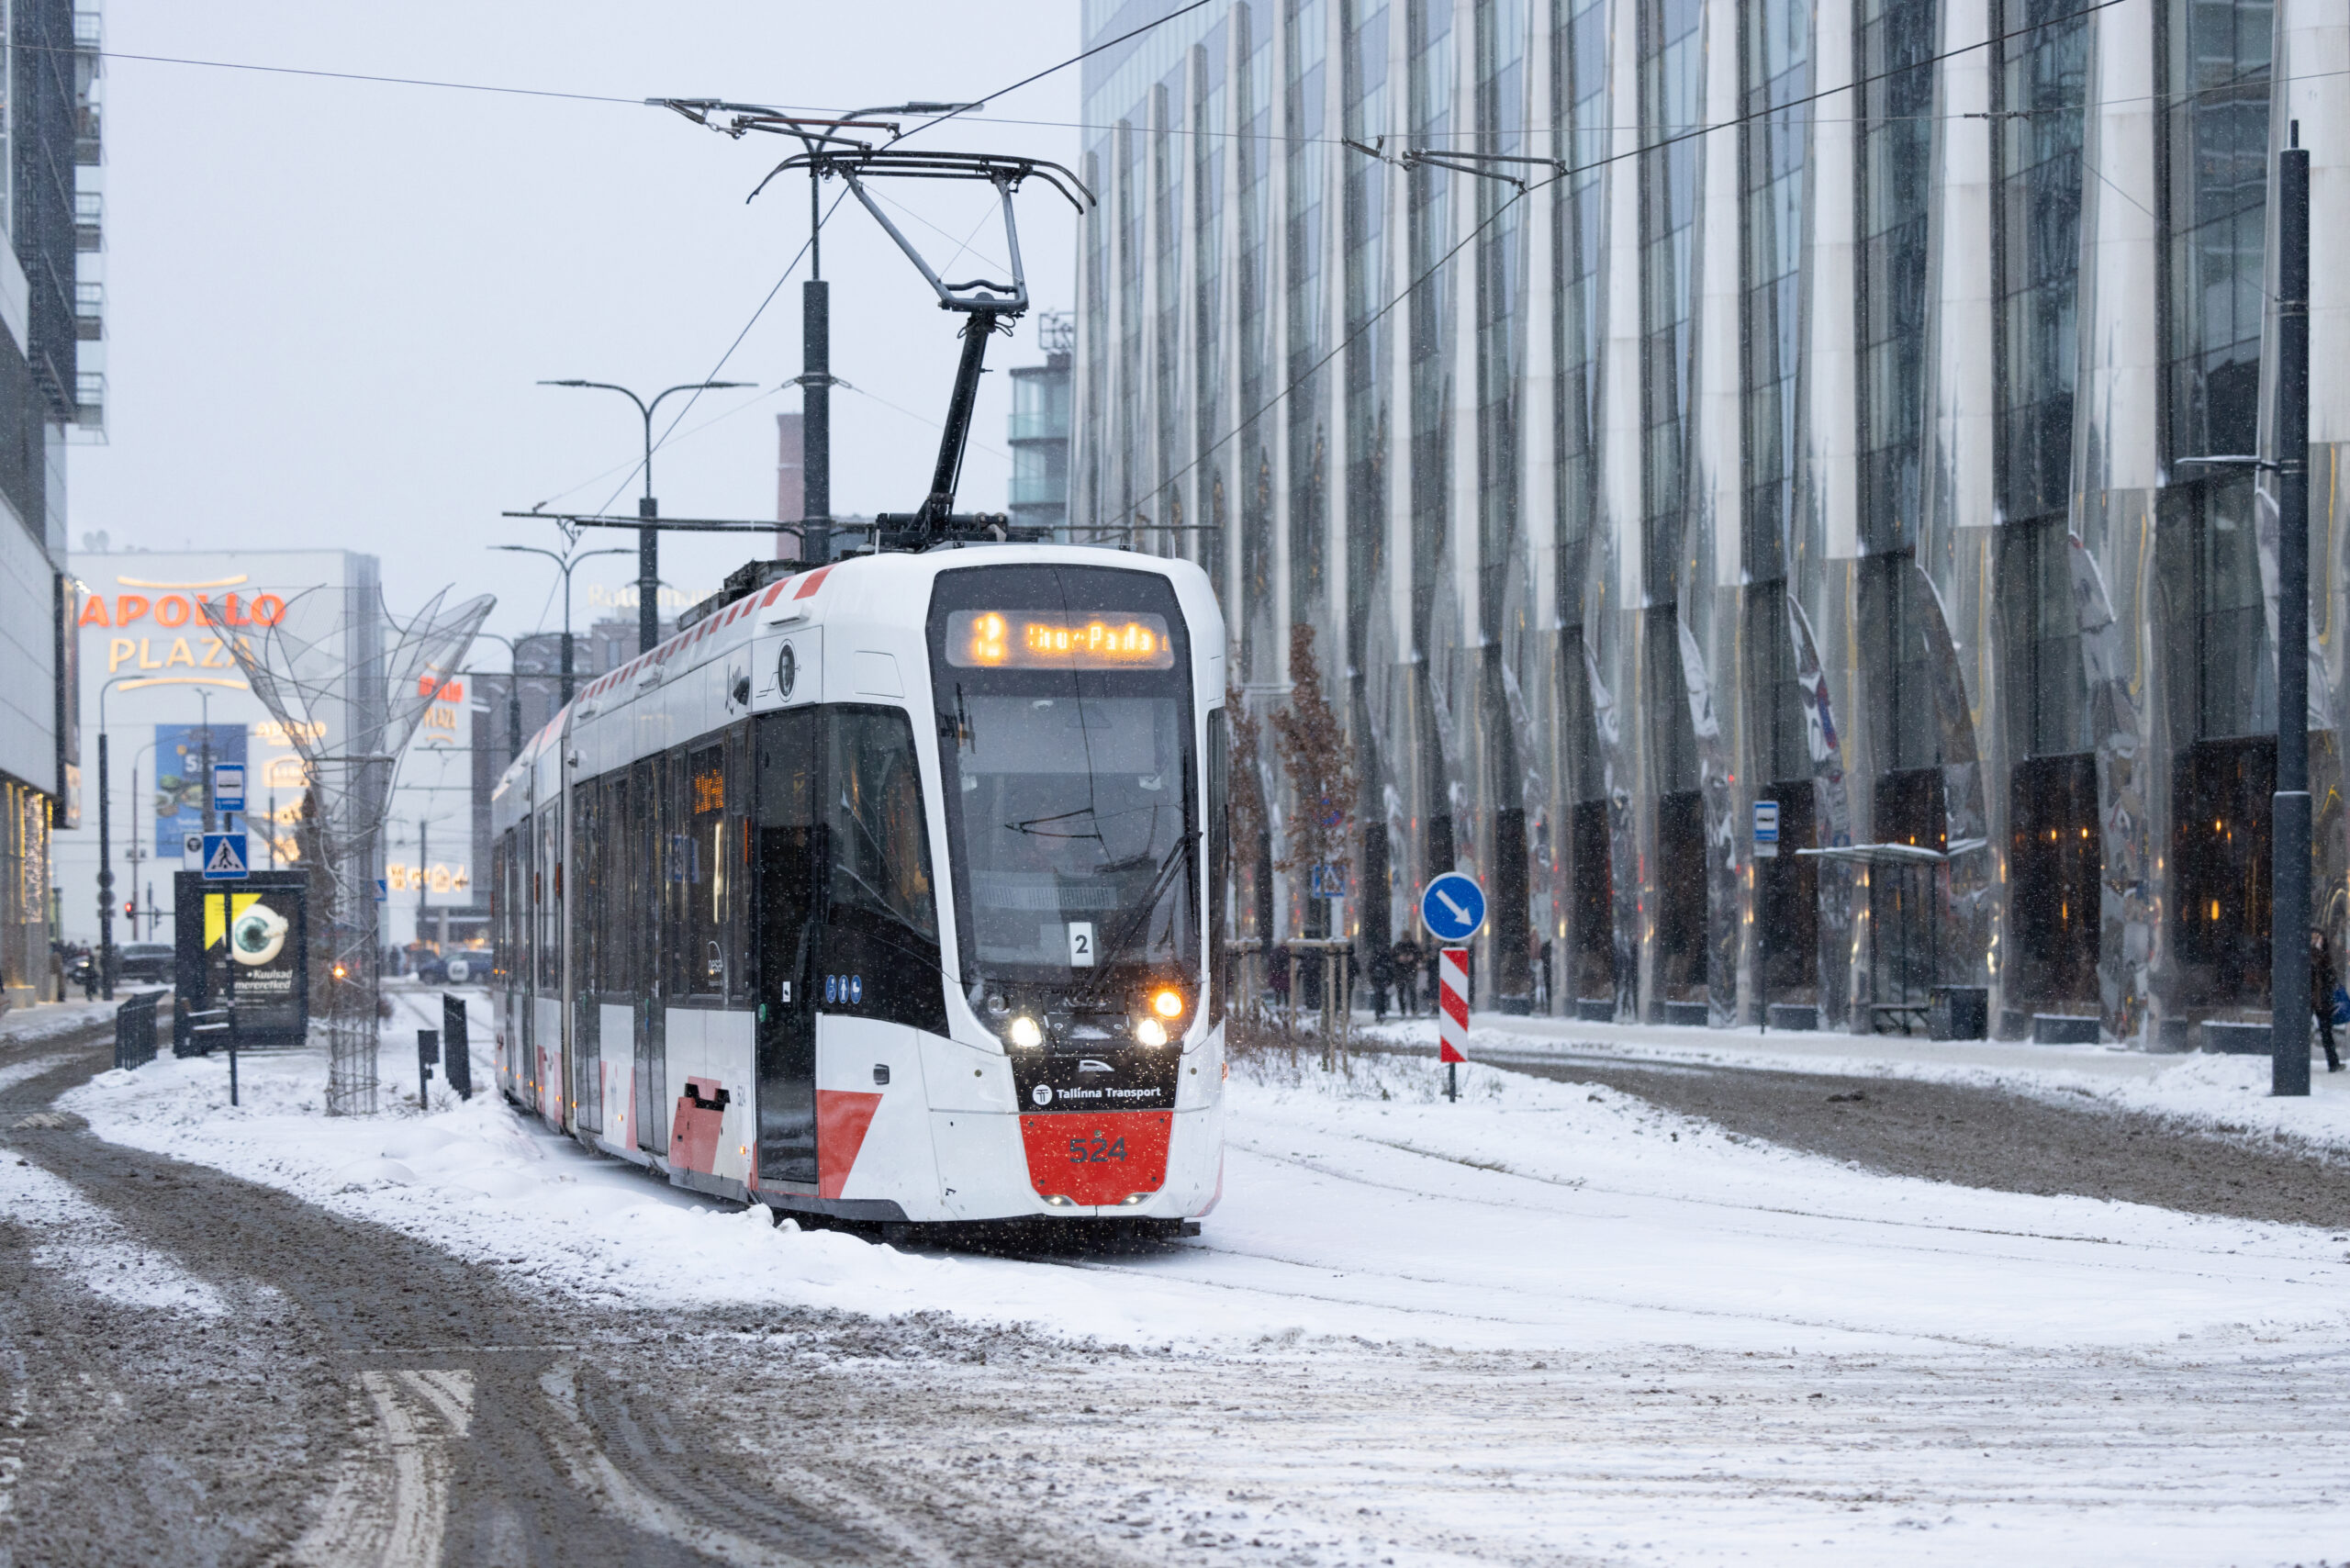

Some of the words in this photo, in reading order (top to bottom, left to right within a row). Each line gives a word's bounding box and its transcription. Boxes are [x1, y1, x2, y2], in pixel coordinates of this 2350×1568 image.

[78, 592, 286, 629] APOLLO
[108, 637, 257, 674] PLAZA
[1075, 935, 1089, 954] 2
[252, 969, 293, 980] Kuulsad
[1057, 1087, 1102, 1100] Tallinna
[1105, 1086, 1161, 1101] Transport
[1069, 1137, 1128, 1164] 524
